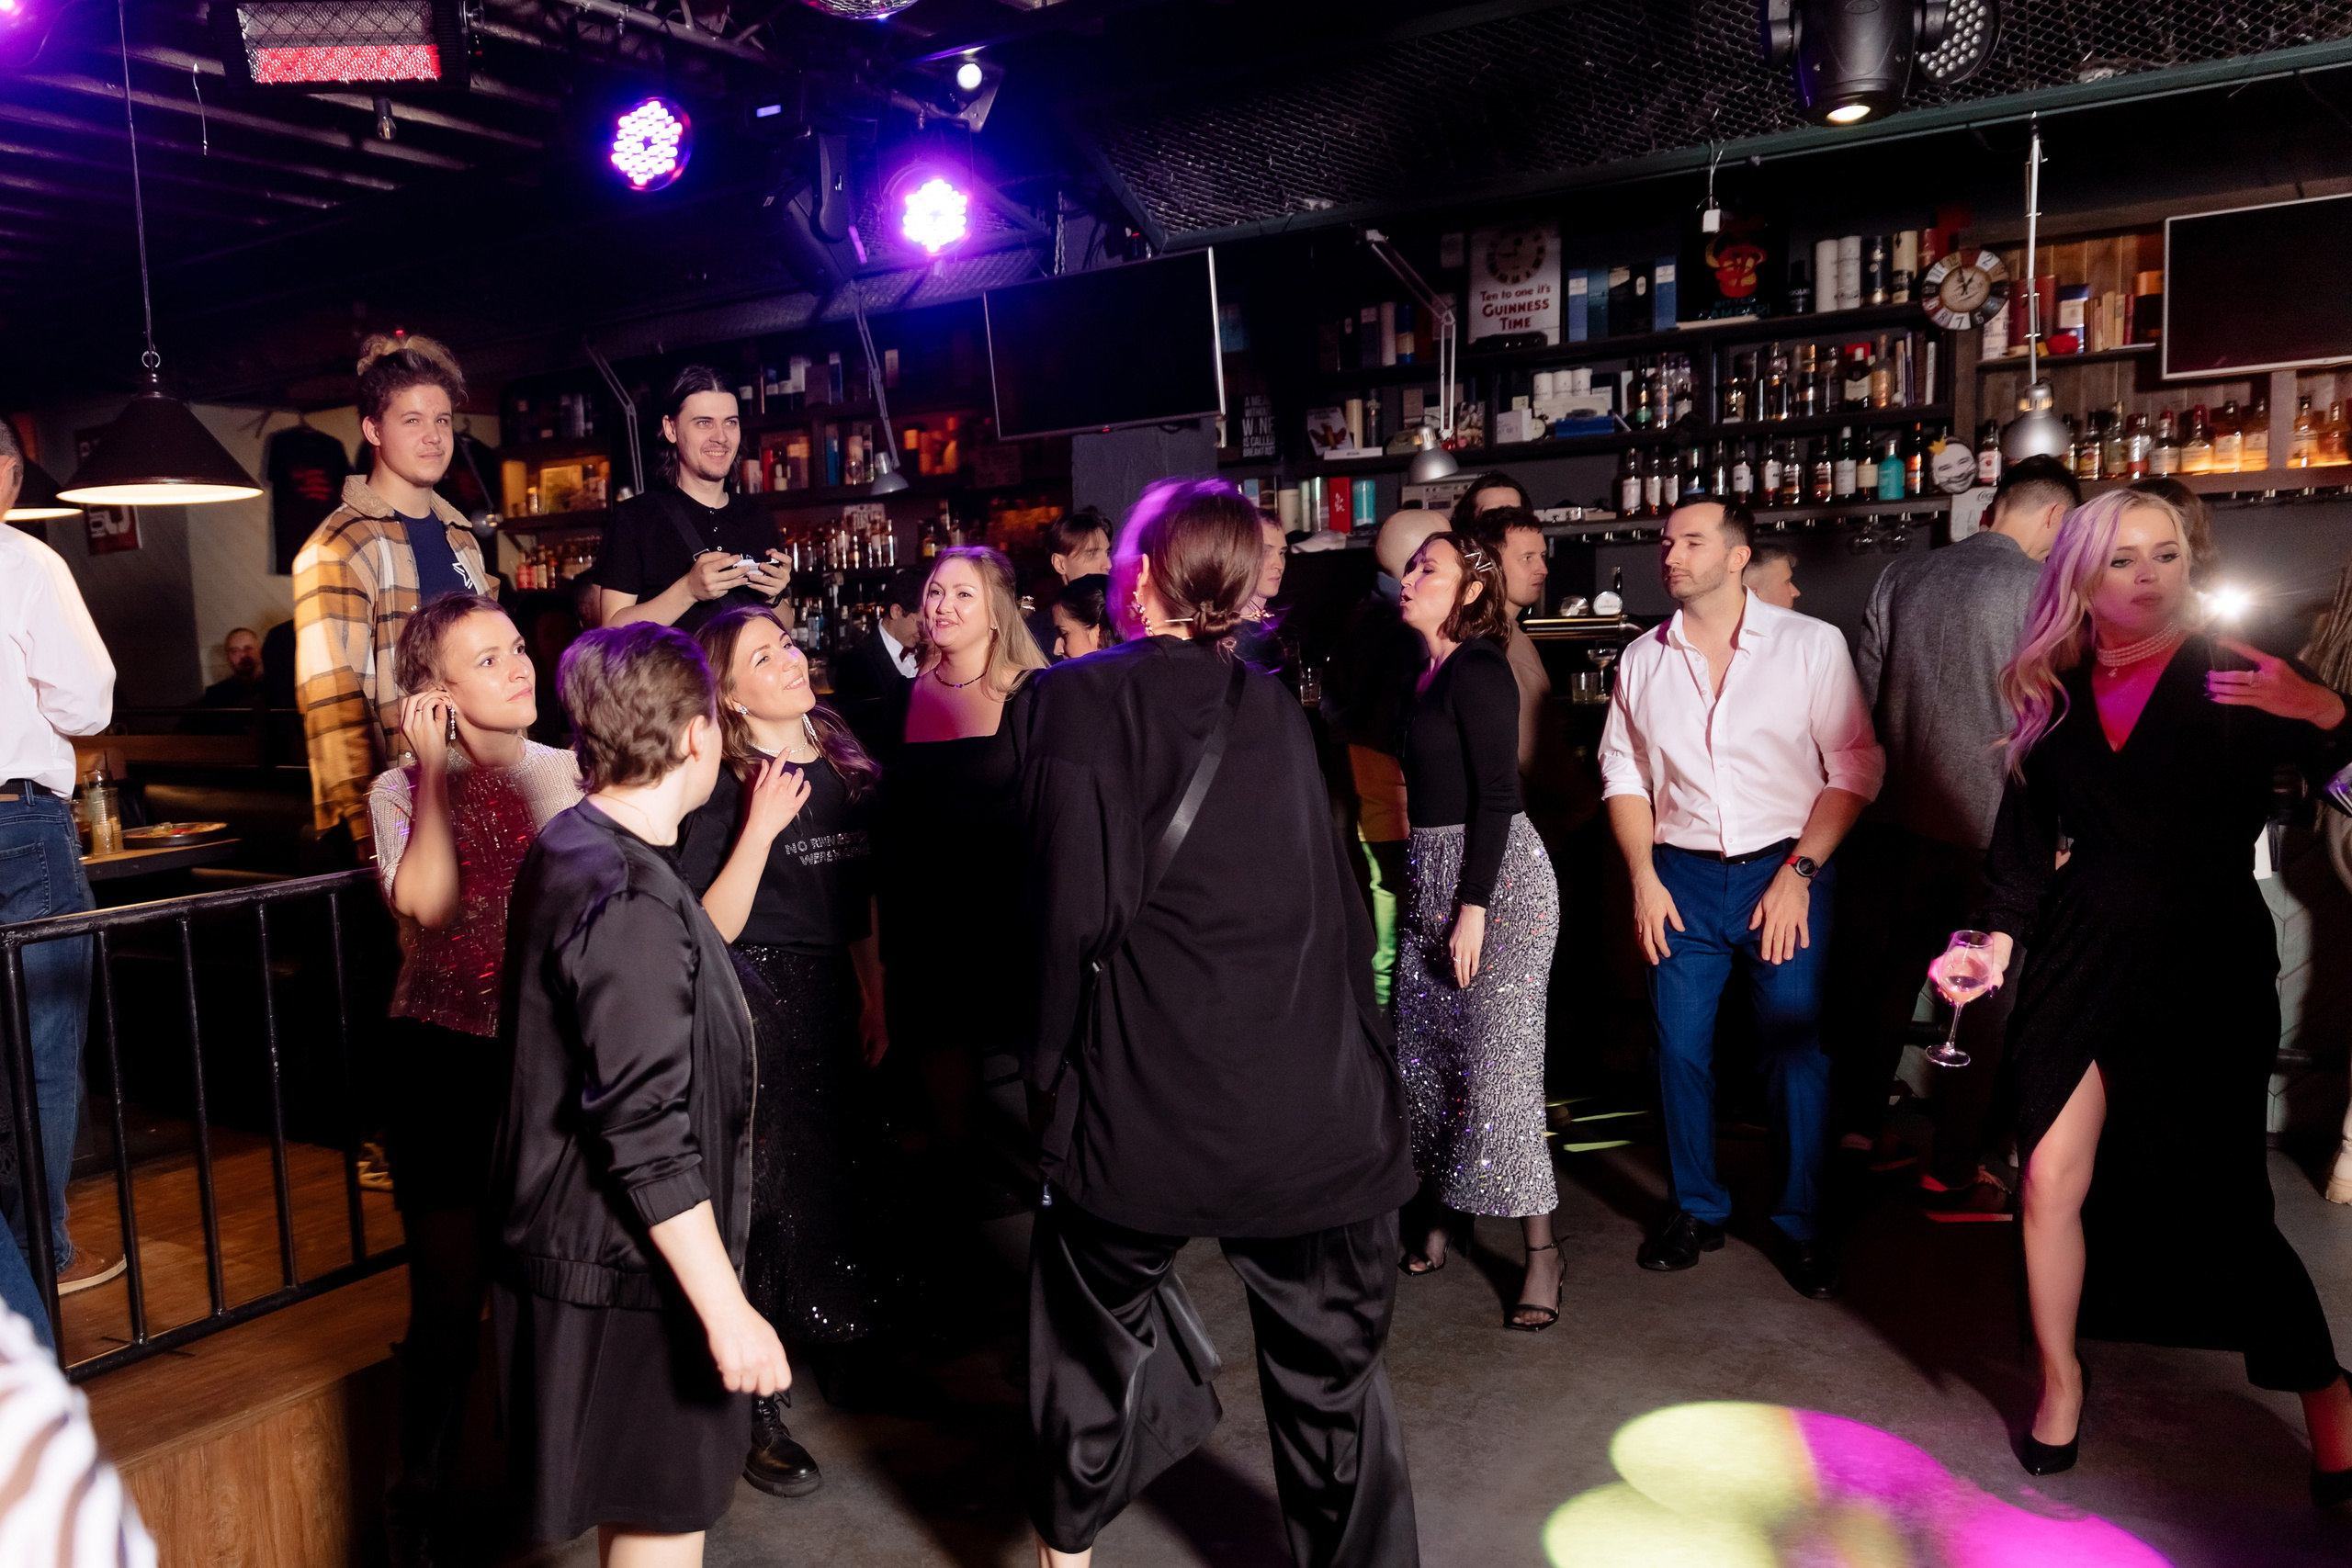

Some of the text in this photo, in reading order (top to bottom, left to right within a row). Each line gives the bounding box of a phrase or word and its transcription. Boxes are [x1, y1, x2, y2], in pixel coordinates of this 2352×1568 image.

[1982, 253, 1995, 266] 2
[1480, 284, 1551, 301] Ten to one it's
[1482, 299, 1550, 318] GUINNESS
[1499, 316, 1532, 331] TIME
[1956, 316, 1964, 329] 7
[785, 840, 808, 855] NO
[799, 851, 833, 865] WERE
